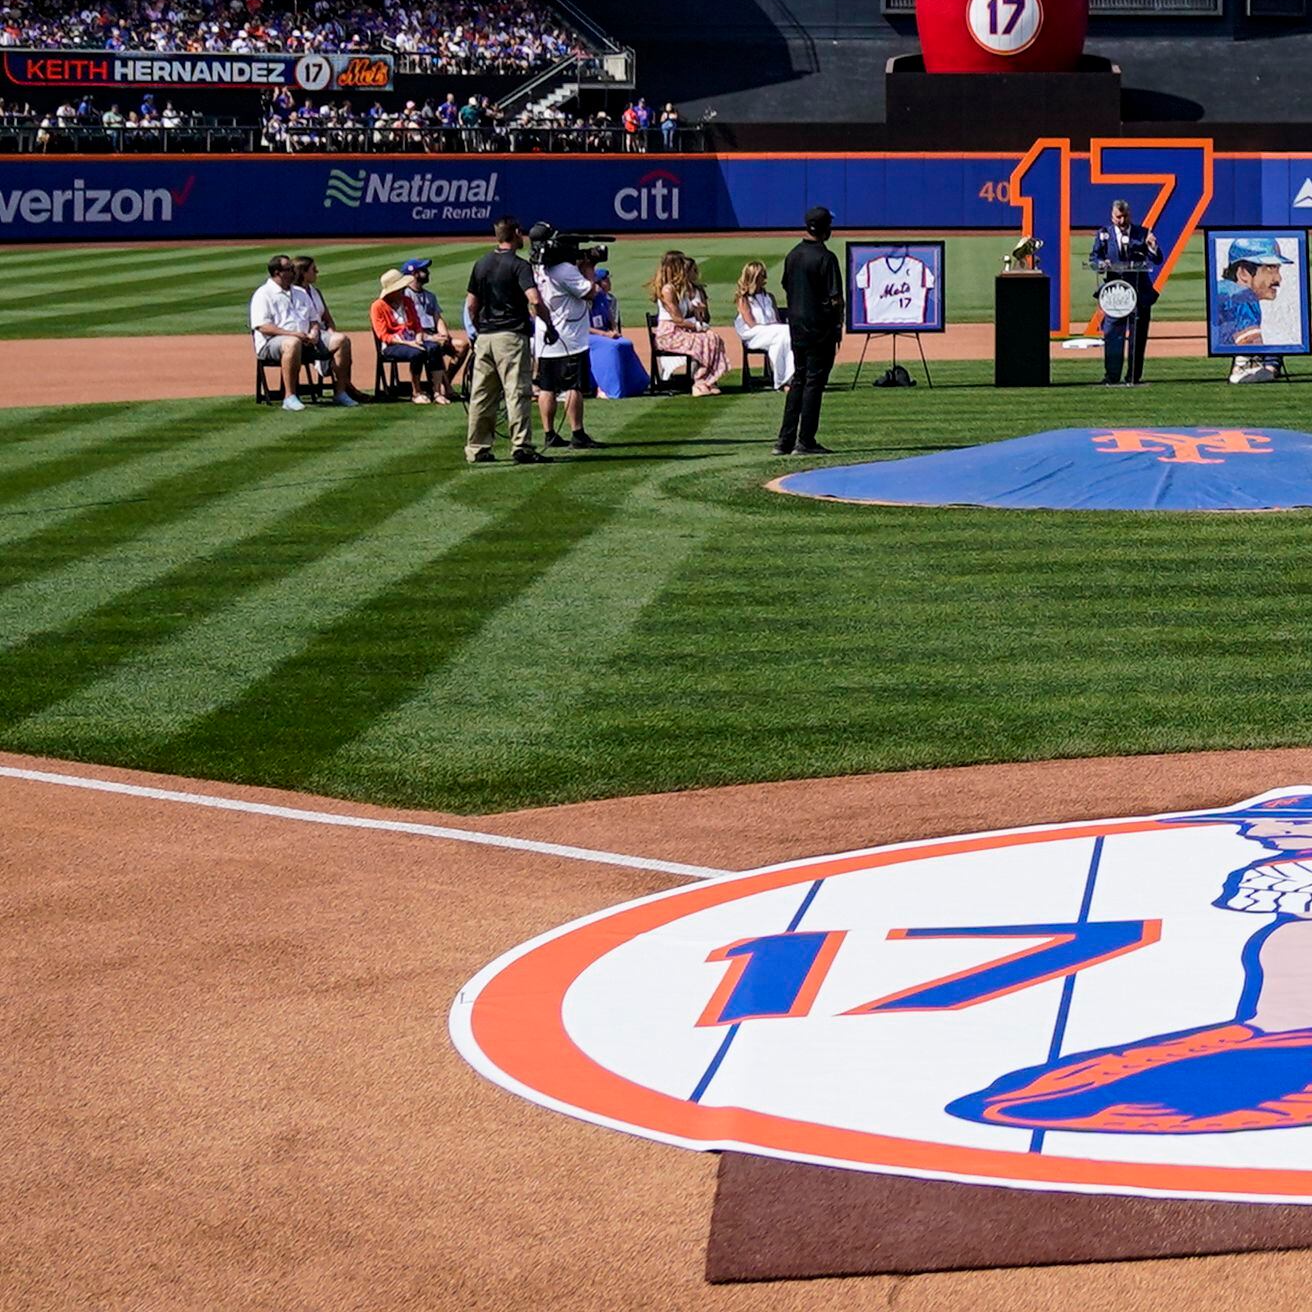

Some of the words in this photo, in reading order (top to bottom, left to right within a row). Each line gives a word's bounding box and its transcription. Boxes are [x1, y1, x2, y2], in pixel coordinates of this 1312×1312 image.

[26, 58, 109, 81] KEITH
[113, 59, 286, 83] HERNANDEZ
[304, 62, 324, 84] 17
[337, 56, 390, 88] Mets
[0, 179, 173, 223] verizon
[364, 170, 498, 204] National
[614, 179, 679, 220] citi
[411, 205, 438, 220] Car
[441, 205, 491, 220] Rental
[1010, 137, 1214, 337] 17
[880, 282, 911, 300] Mets
[899, 297, 912, 309] 17
[695, 918, 1162, 1030] 17
